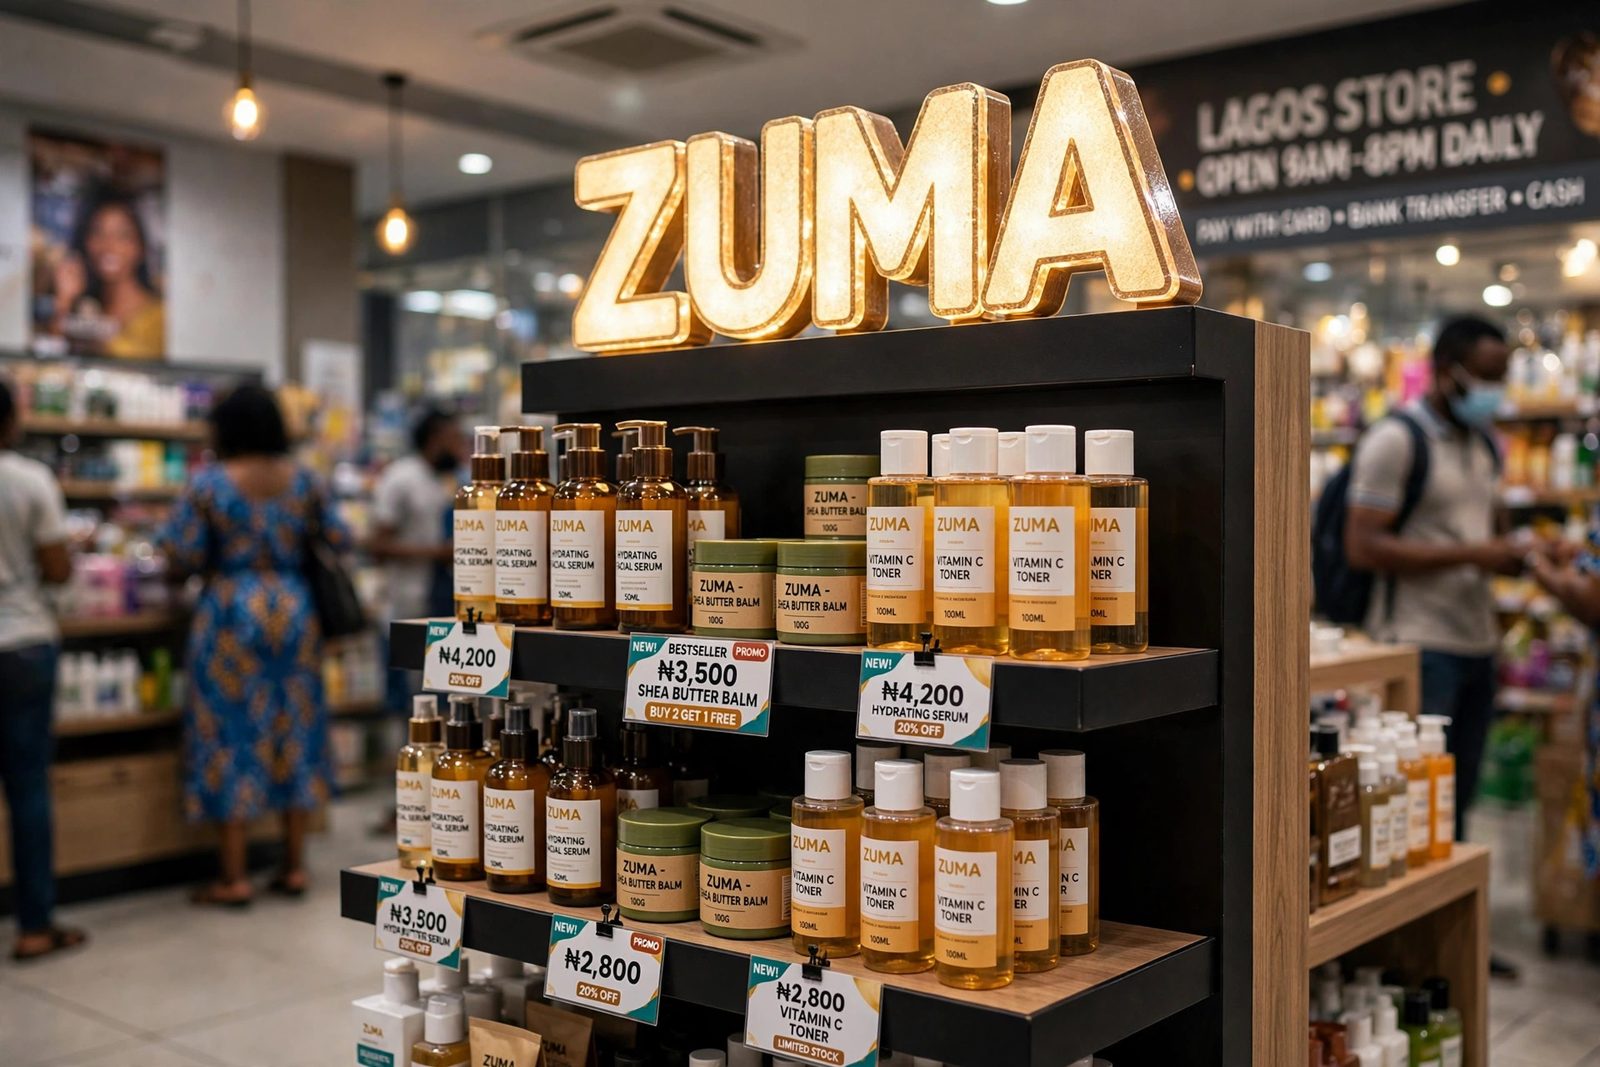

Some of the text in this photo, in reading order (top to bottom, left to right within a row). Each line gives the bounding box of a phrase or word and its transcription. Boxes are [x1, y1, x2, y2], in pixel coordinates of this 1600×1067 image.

[1197, 59, 1477, 150] LAGOS STORE
[1197, 147, 1277, 198] OPEN
[1442, 111, 1543, 167] DAILY
[571, 58, 1203, 354] ZUMA
[1196, 177, 1585, 245] PAY WITH CARD BANK TRANSFER CASH
[815, 490, 849, 503] ZUMA
[820, 507, 847, 516] BUTTER
[496, 519, 529, 532] ZUMA
[552, 519, 586, 532] ZUMA
[617, 519, 654, 533] ZUMA
[688, 519, 707, 531] MA
[822, 524, 838, 532] 100G
[869, 517, 911, 531] ZUMA
[937, 517, 980, 532] ZUMA
[1013, 517, 1060, 533] ZUMA
[511, 559, 537, 568] SERUM
[567, 561, 595, 570] SERUM
[634, 562, 663, 572] SERUM
[869, 554, 914, 566] VITAMIN C
[936, 556, 984, 567] VITAMIN C
[1013, 558, 1064, 569] VITAMIN C
[872, 567, 901, 578] TONER
[940, 569, 970, 580] TONER
[1017, 571, 1050, 582] TONER
[1091, 569, 1112, 580] NER
[700, 579, 735, 593] ZUMA
[785, 583, 821, 597] ZUMA
[624, 593, 640, 601] 50ML
[706, 597, 734, 607] BUTTER
[736, 598, 760, 607] BALM
[791, 601, 821, 611] BUTTER
[823, 601, 847, 612] BALM
[876, 607, 897, 616] 100ML
[708, 616, 723, 624] 100G
[944, 610, 966, 619] 100ML
[1022, 613, 1046, 623] 100ML
[793, 620, 809, 629] 100G
[632, 641, 657, 653] NEW!
[668, 643, 727, 659] BESTSELLER
[735, 646, 766, 658] PROMO
[439, 646, 496, 670] ₦4,200
[865, 657, 892, 669] NEW!
[657, 659, 738, 687] ₦3,500
[466, 676, 481, 687] OFF
[638, 684, 758, 708] SHEA BUTTER BALM
[882, 680, 964, 707] ₦4,200
[650, 705, 737, 726] BUY 2 GET 1 FREE
[872, 704, 969, 724] HYDRATING SERUM
[896, 721, 942, 736] 20% OFF
[485, 795, 516, 810] ZUMA
[548, 805, 582, 821] ZUMA
[445, 824, 469, 832] SERUM
[498, 834, 525, 844] SERUM
[793, 835, 831, 853] ZUMA
[564, 847, 590, 856] SERUM
[863, 847, 904, 866] ZUMA
[1014, 850, 1036, 865] MA
[623, 860, 657, 876] ZUMA
[938, 858, 982, 877] ZUMA
[628, 877, 656, 889] BUTTER
[658, 880, 682, 890] BALM
[706, 874, 742, 892] ZUMA
[793, 869, 835, 885] VITAMIN C
[795, 882, 822, 897] TONER
[863, 883, 907, 898] VITAMIN C
[630, 897, 646, 907] 100G
[713, 892, 741, 906] BUTTER
[743, 896, 768, 907] BALM
[866, 896, 895, 910] TONER
[937, 894, 985, 911] VITAMIN C
[714, 912, 730, 923] 100G
[941, 909, 972, 924] TONER
[554, 921, 578, 935] NEW!
[799, 920, 818, 931] 100ML
[633, 937, 660, 951] PROMO
[870, 934, 890, 946] 100ML
[946, 949, 967, 961] 100ML
[565, 947, 641, 984] ₦2,800
[753, 962, 779, 978] NEW!
[579, 985, 618, 1003] 20% OFF
[776, 981, 845, 1012] ₦2,800
[780, 1005, 843, 1031] VITAMIN C
[789, 1023, 829, 1043] TONER
[778, 1039, 839, 1063] LIMITED STOCK
[483, 1054, 515, 1067] ZUMA
